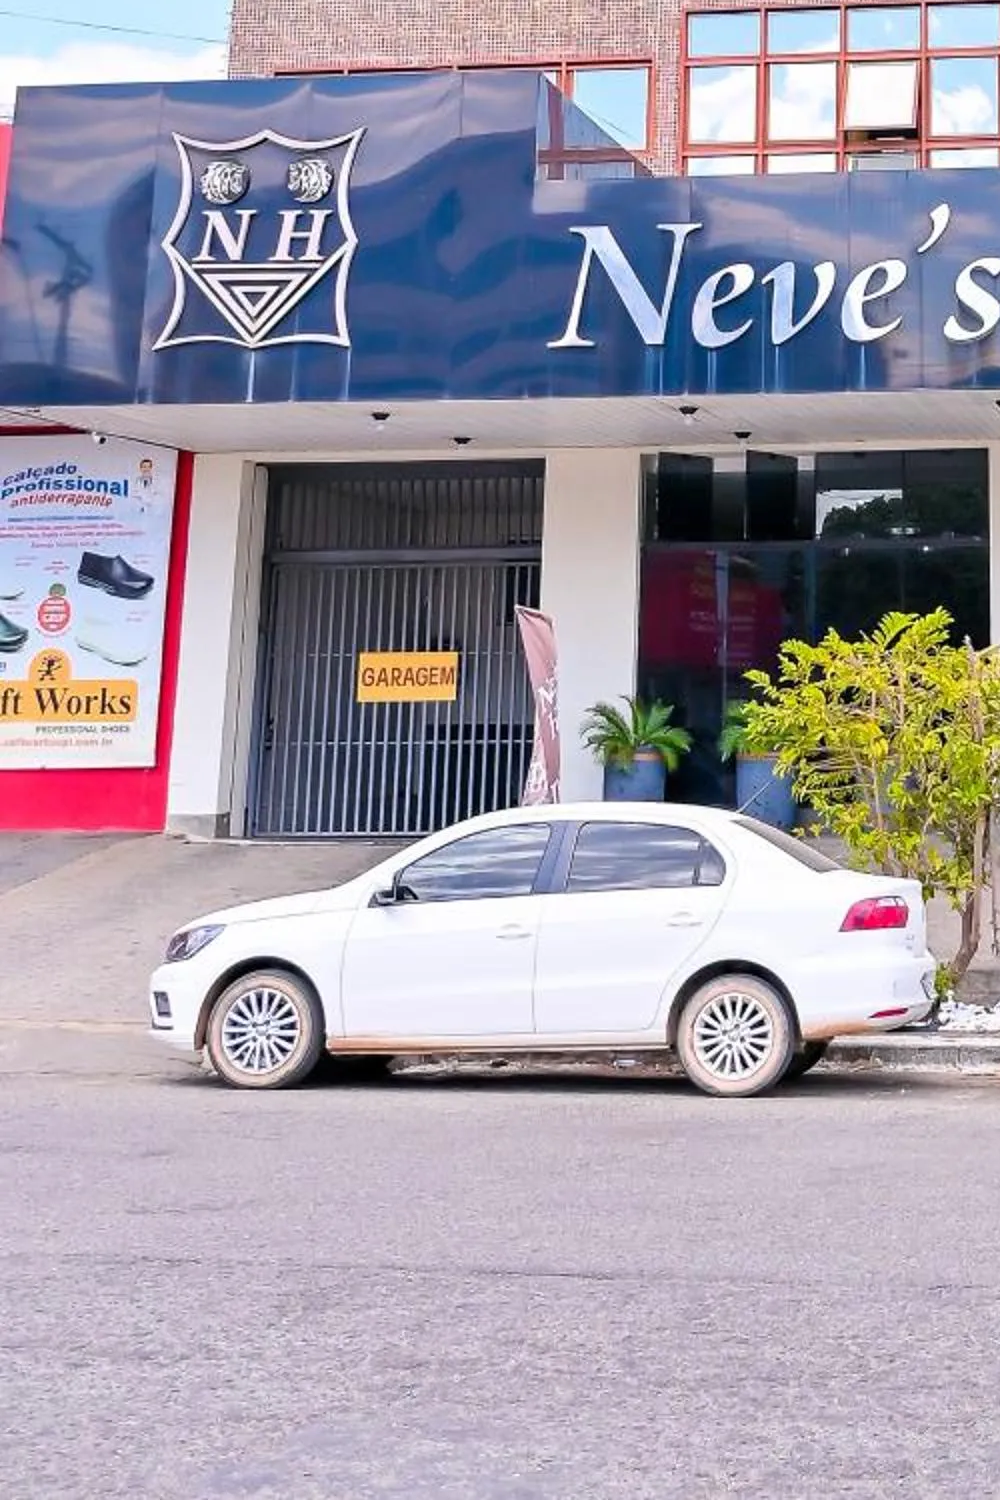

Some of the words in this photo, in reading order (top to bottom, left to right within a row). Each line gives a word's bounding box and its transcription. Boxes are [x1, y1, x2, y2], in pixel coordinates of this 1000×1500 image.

[3, 461, 78, 487] calçado
[0, 475, 129, 500] profissional
[10, 492, 114, 508] antiderrapante
[361, 666, 455, 688] GARAGEM
[34, 687, 132, 716] Works
